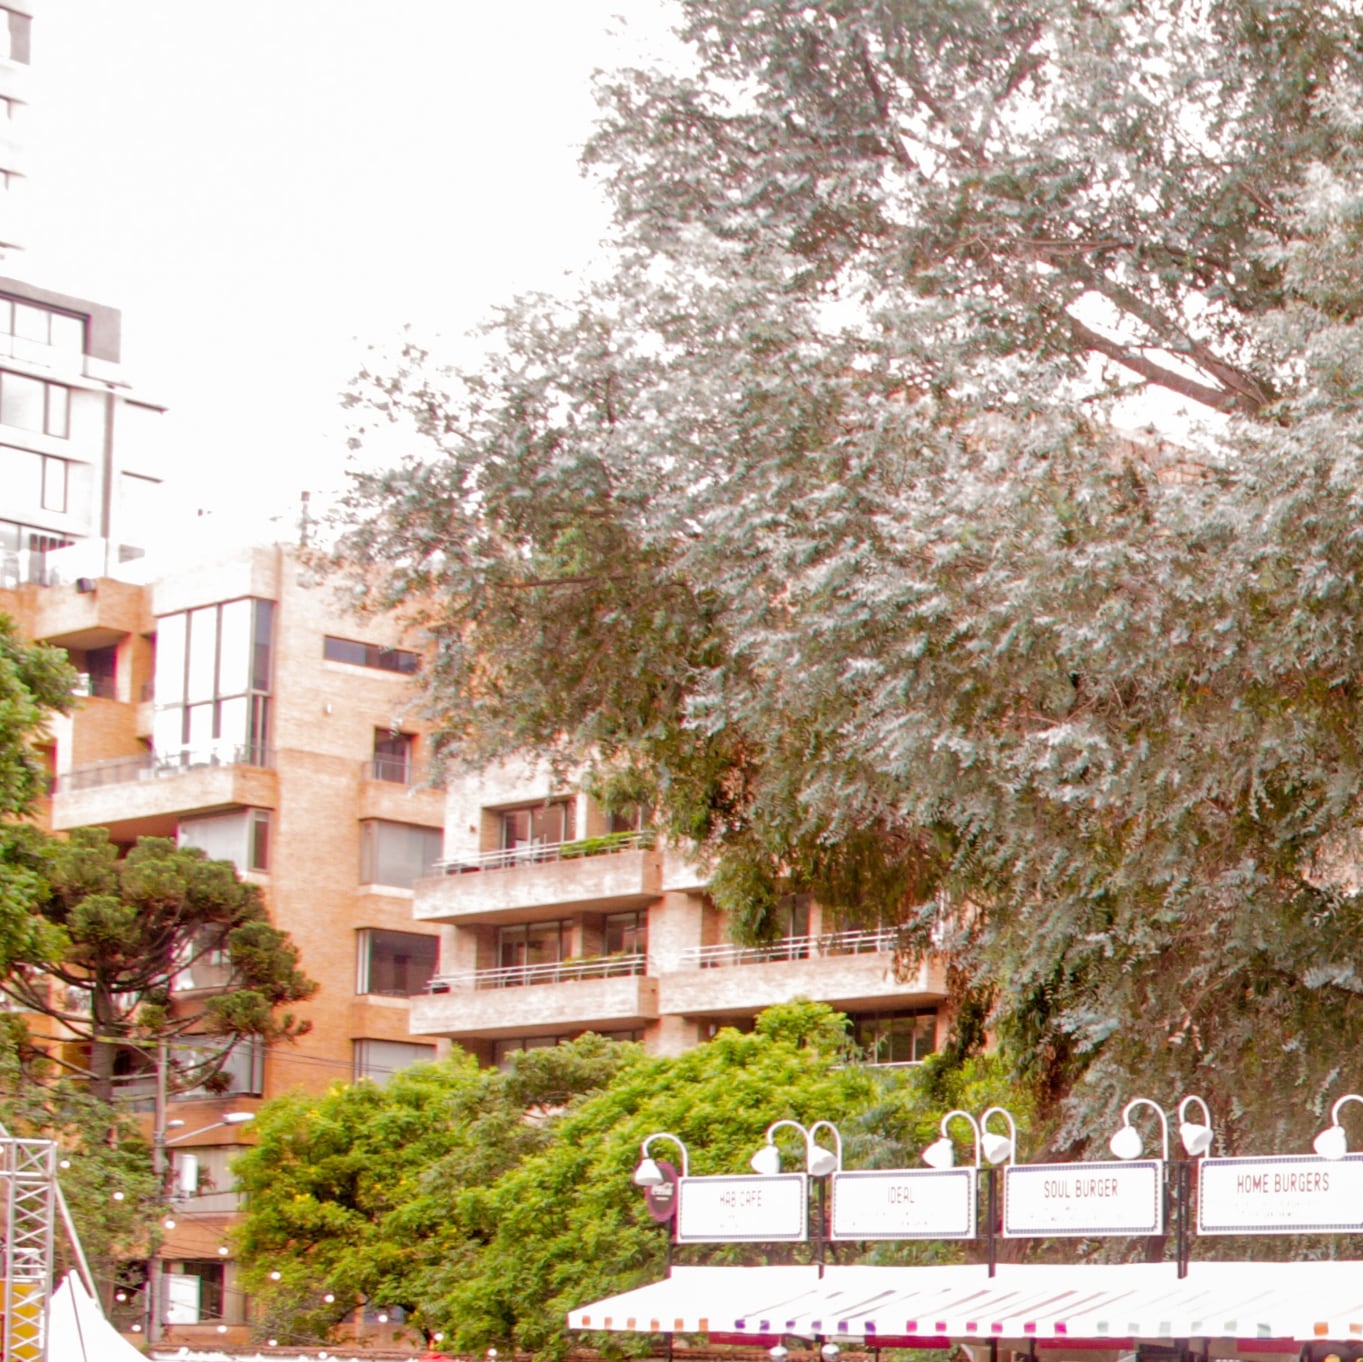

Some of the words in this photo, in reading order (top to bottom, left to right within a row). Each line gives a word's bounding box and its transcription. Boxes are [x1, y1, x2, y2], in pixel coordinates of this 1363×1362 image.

[1044, 1179, 1071, 1199] SOUL
[1075, 1178, 1118, 1198] BURGER
[1237, 1173, 1269, 1194] HOME
[1274, 1171, 1329, 1193] BURGERS
[887, 1186, 915, 1204] IDEAL
